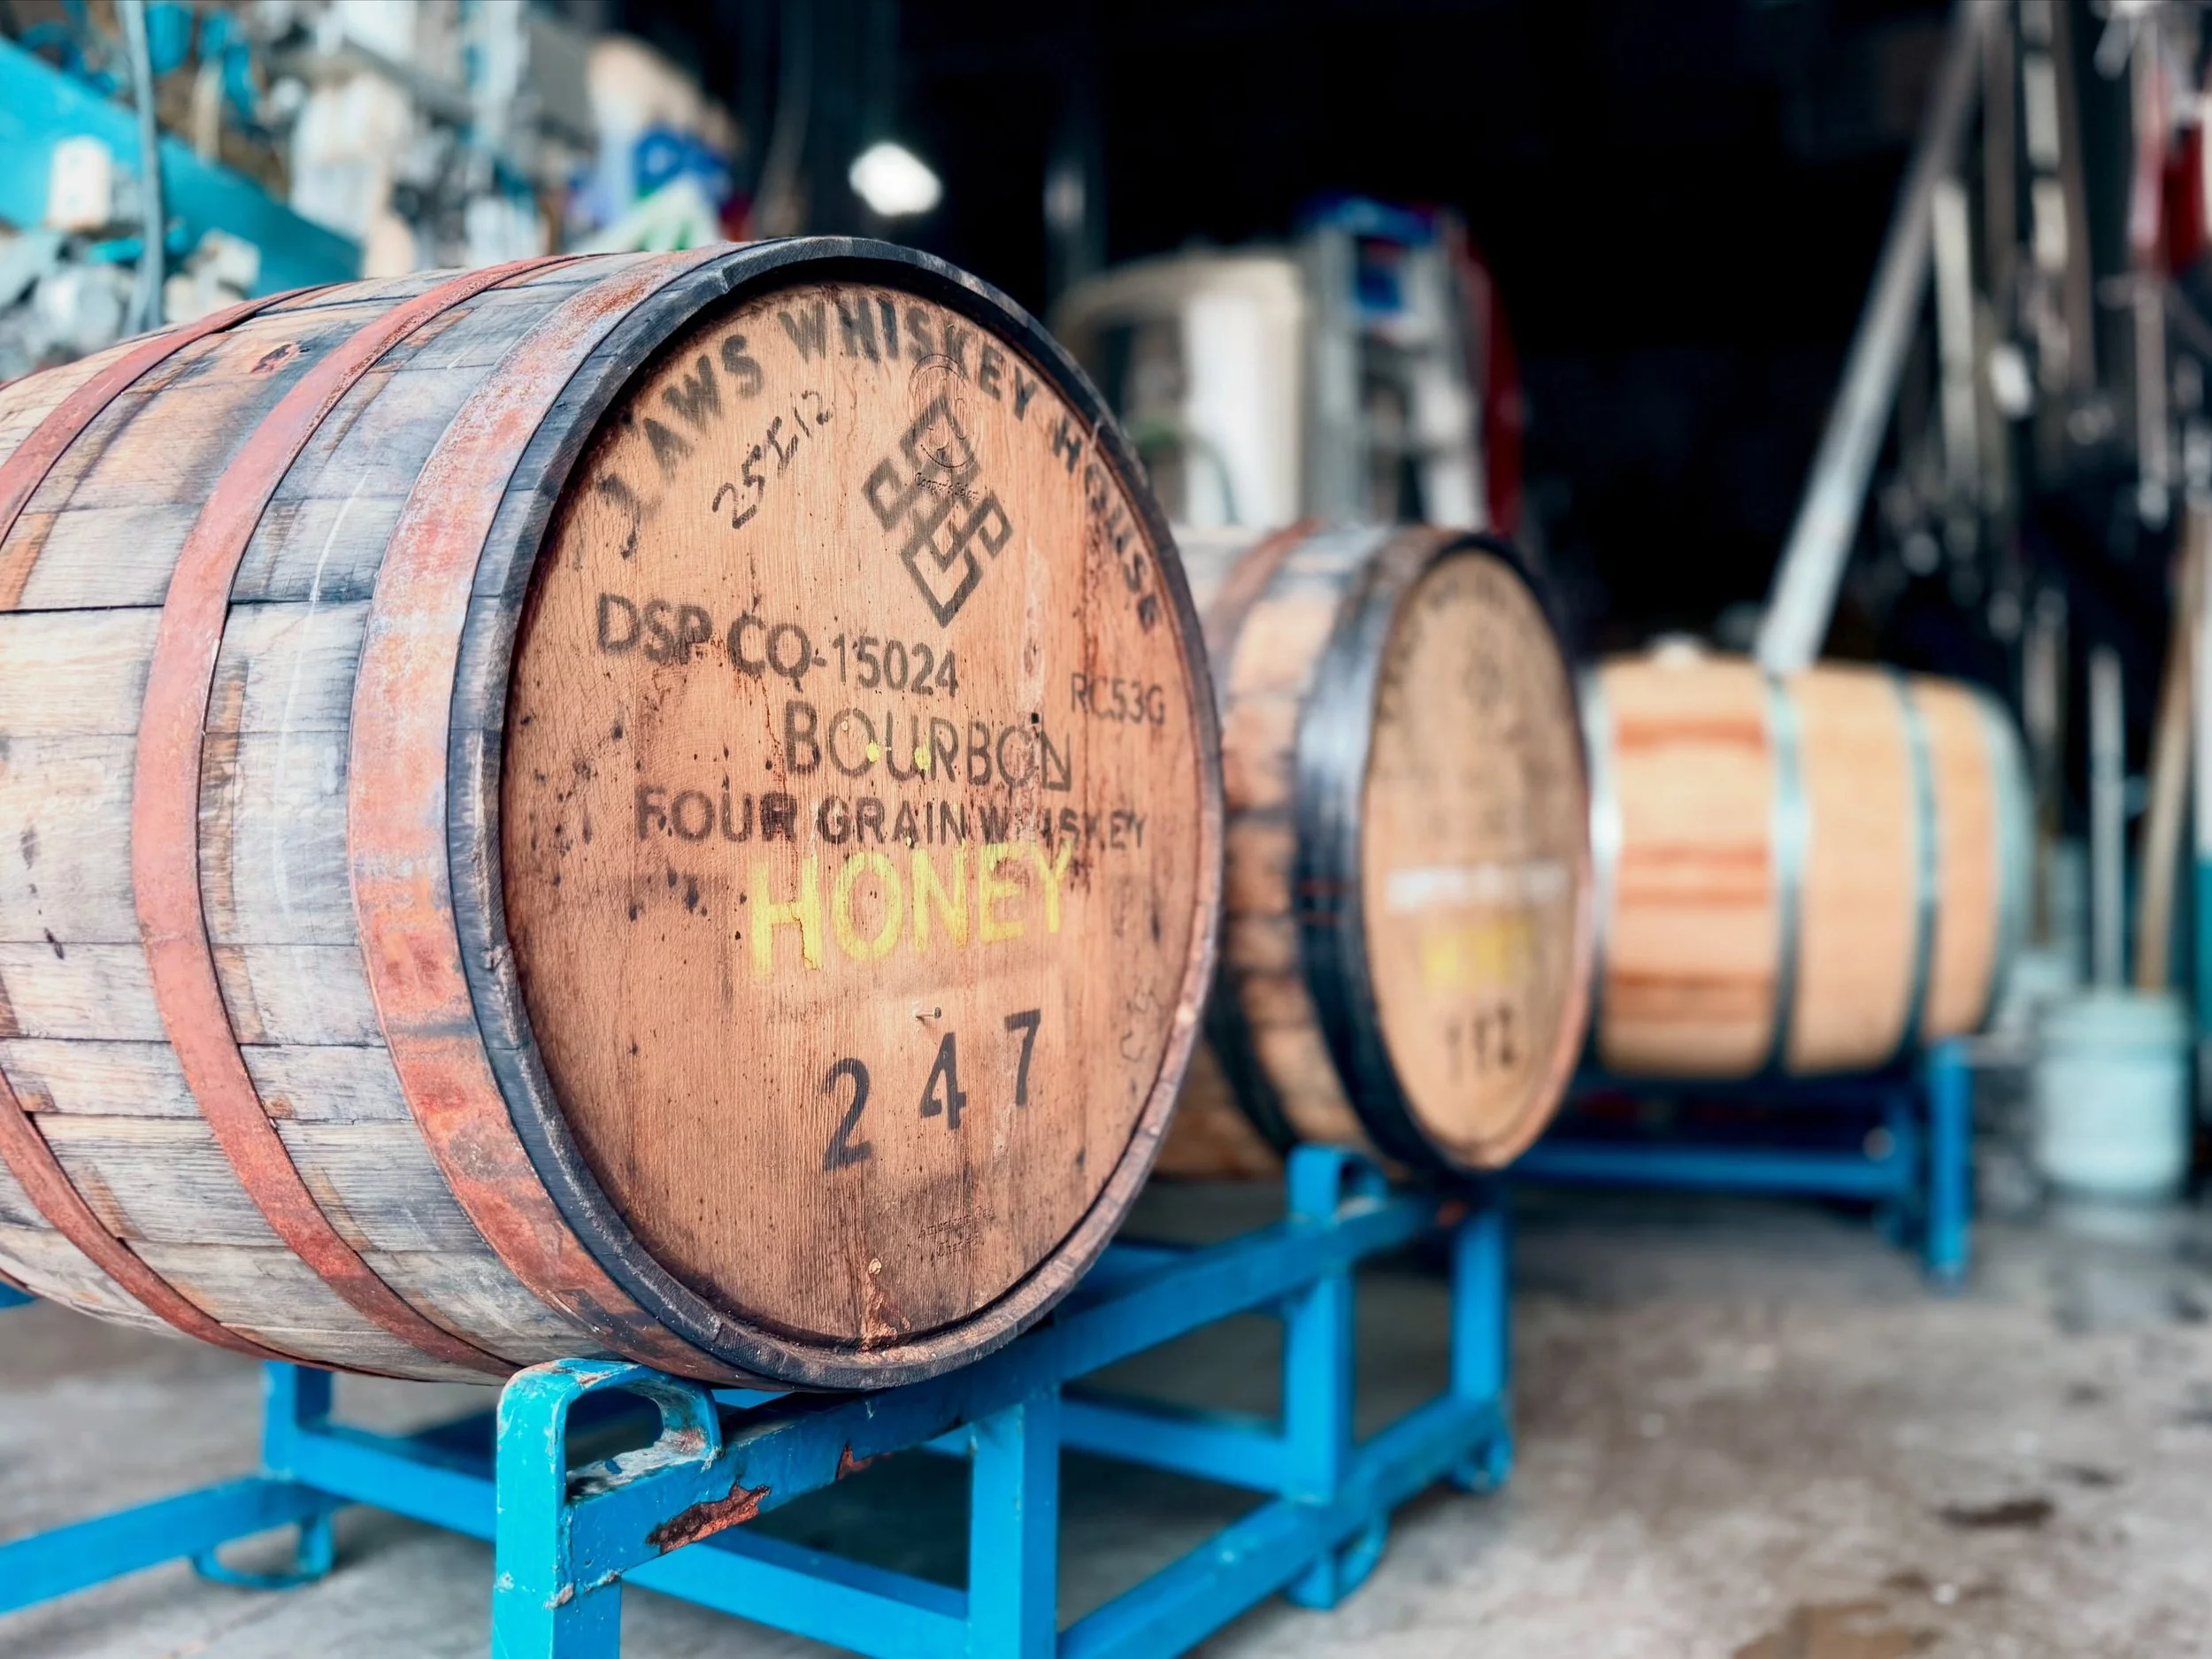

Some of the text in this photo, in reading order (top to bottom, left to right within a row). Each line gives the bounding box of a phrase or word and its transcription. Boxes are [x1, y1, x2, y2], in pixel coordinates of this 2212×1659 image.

[778, 296, 1038, 422] WHISKEY
[598, 593, 712, 665] DSP
[785, 699, 1071, 792] BOURBON
[634, 784, 797, 842] FOUR
[817, 795, 966, 846] GRAIN
[748, 839, 1072, 984] HONEY
